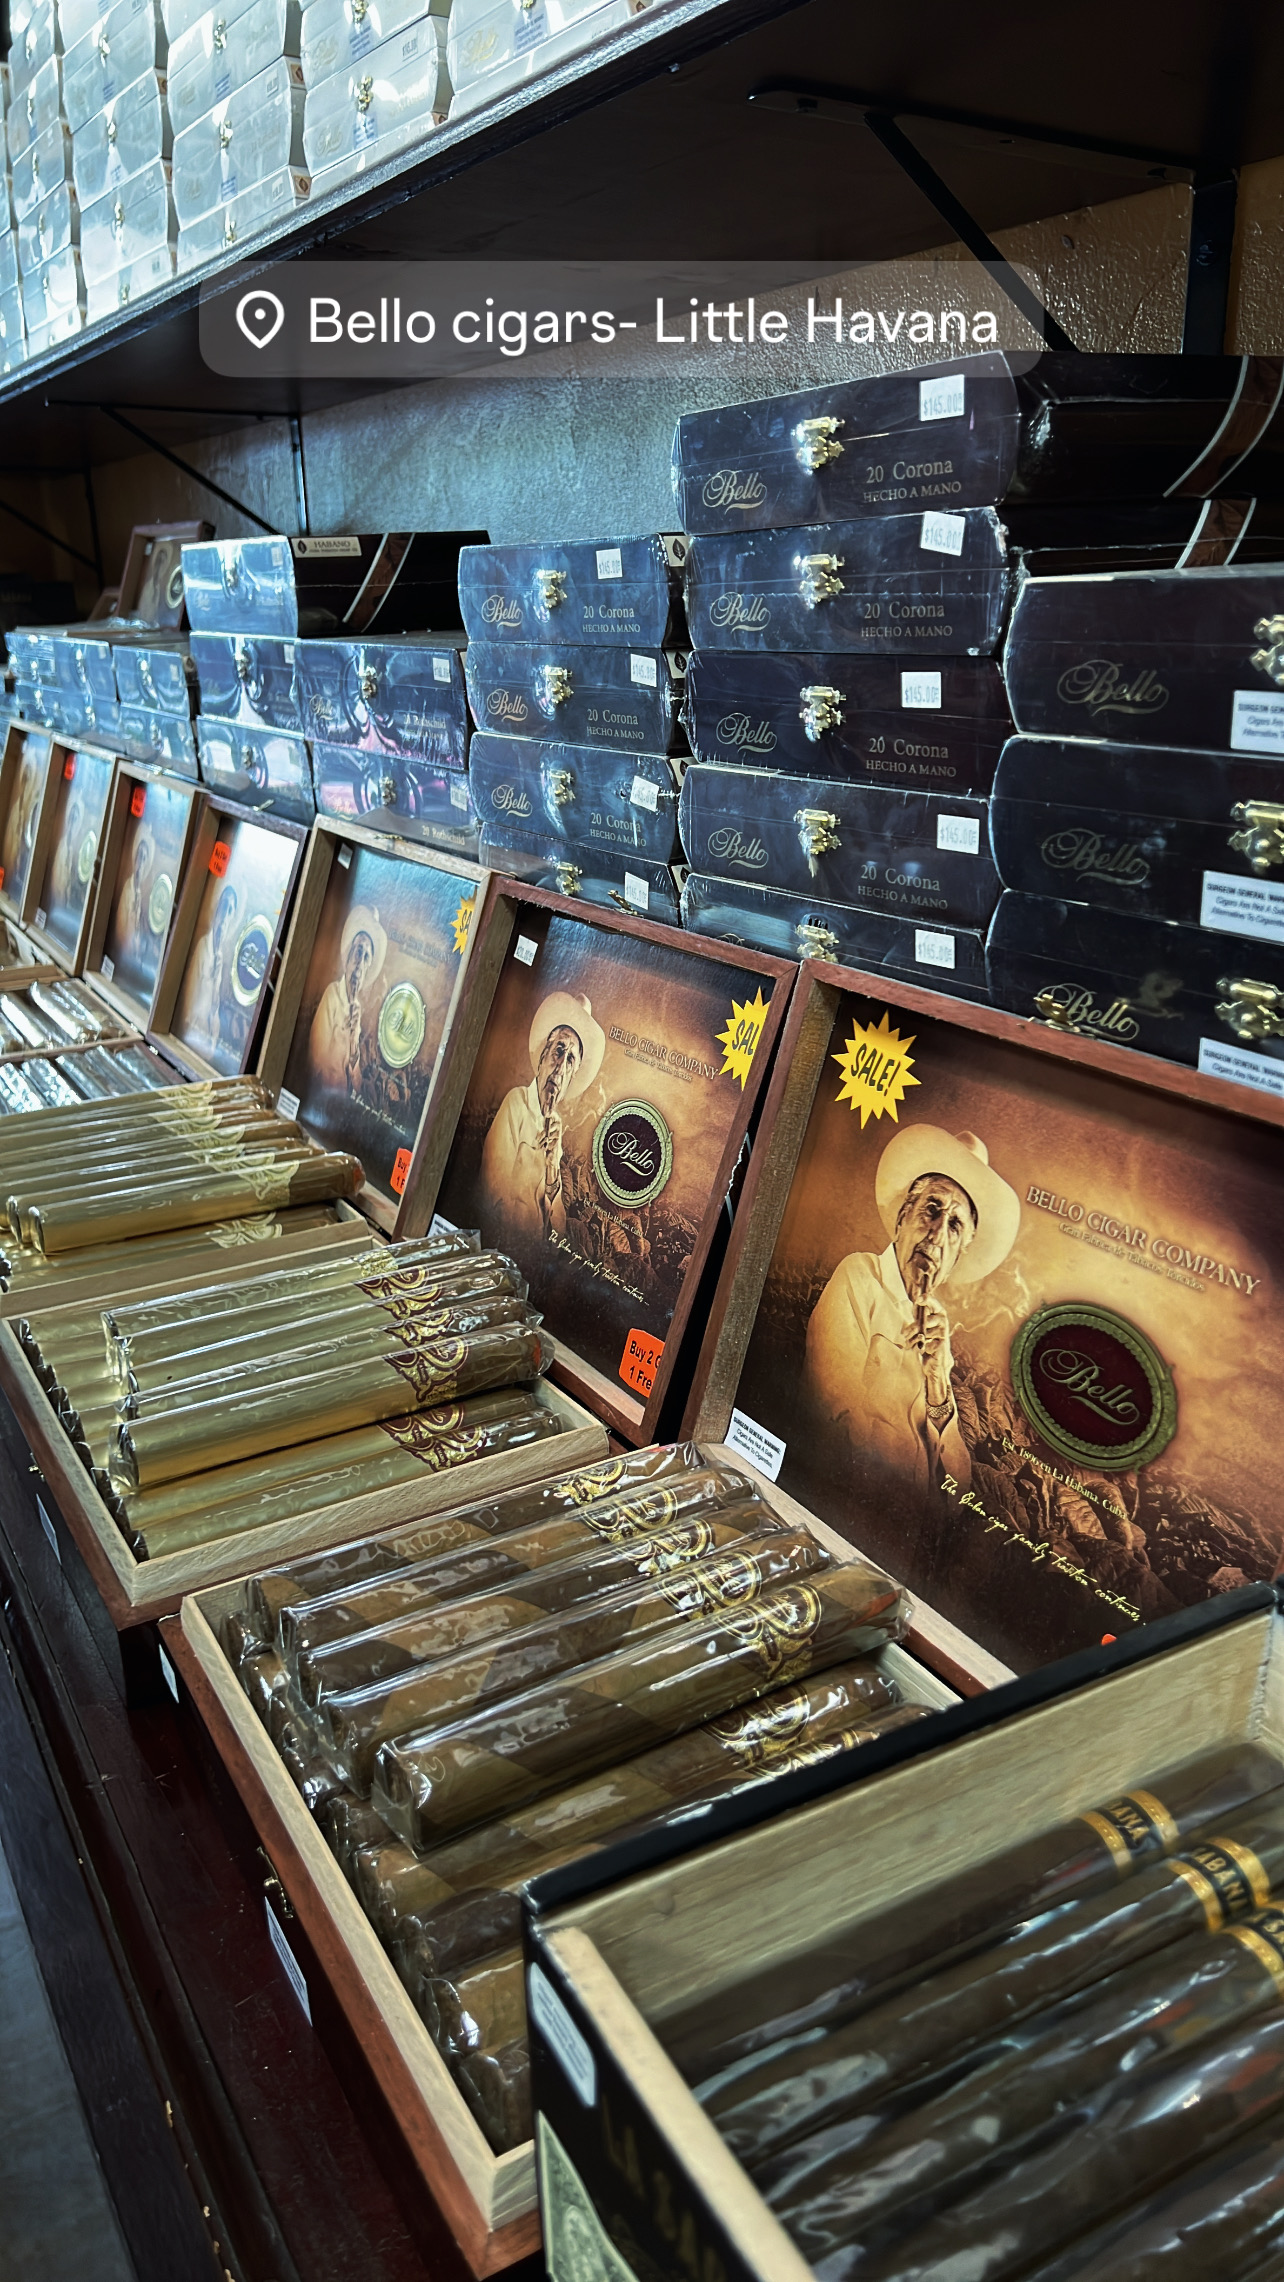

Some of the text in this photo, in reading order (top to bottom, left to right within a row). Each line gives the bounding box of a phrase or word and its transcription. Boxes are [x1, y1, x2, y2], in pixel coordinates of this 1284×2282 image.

[866, 459, 954, 484] 20 Corona
[702, 469, 768, 514] Bello
[863, 480, 962, 503] HECHO A MANO
[313, 540, 350, 549] HABANO
[481, 594, 524, 630] Bello
[583, 604, 635, 619] 20 Corona
[709, 591, 771, 634] Bello
[863, 602, 945, 619] 20 Corona
[582, 624, 609, 633] HECHO
[617, 623, 641, 633] MANO
[861, 625, 953, 638] HECHO A MANO
[1056, 659, 1170, 717] Bello
[487, 688, 528, 722] Bello
[587, 708, 639, 725] 20 Corona
[586, 726, 614, 736] HECHO
[620, 730, 645, 740] MANO
[716, 712, 777, 753] Bello
[868, 736, 949, 759] 20 Corona
[865, 760, 907, 773] HECHO
[917, 763, 957, 777] MANO
[491, 784, 533, 817] Bello
[591, 812, 641, 833] 20 Corona
[590, 829, 616, 841] HECHO
[623, 834, 647, 847] MANO
[707, 827, 769, 869] Bello
[1041, 828, 1150, 886] Bello
[860, 864, 941, 892] 20 Corona
[857, 884, 899, 901] HECHO
[910, 892, 948, 910] MANO
[1036, 983, 1141, 1042] Bello
[609, 1026, 638, 1047] BELLO
[638, 1038, 667, 1060] CIGAR
[668, 1050, 719, 1080] COMPANY
[850, 1042, 901, 1097] SALE!
[607, 1131, 655, 1177] Bello
[1026, 1185, 1261, 1296] BELLO CIGAR COMPANY
[629, 1339, 646, 1363] Buy
[646, 1350, 654, 1365] 2
[629, 1365, 636, 1380] 1
[1039, 1348, 1140, 1426] Bello
[1052, 1467, 1064, 1481] La
[1102, 1499, 1128, 1520] Cuba
[940, 1473, 958, 1496] The
[1003, 1533, 1050, 1562] family
[1048, 1550, 1098, 1586] tradition
